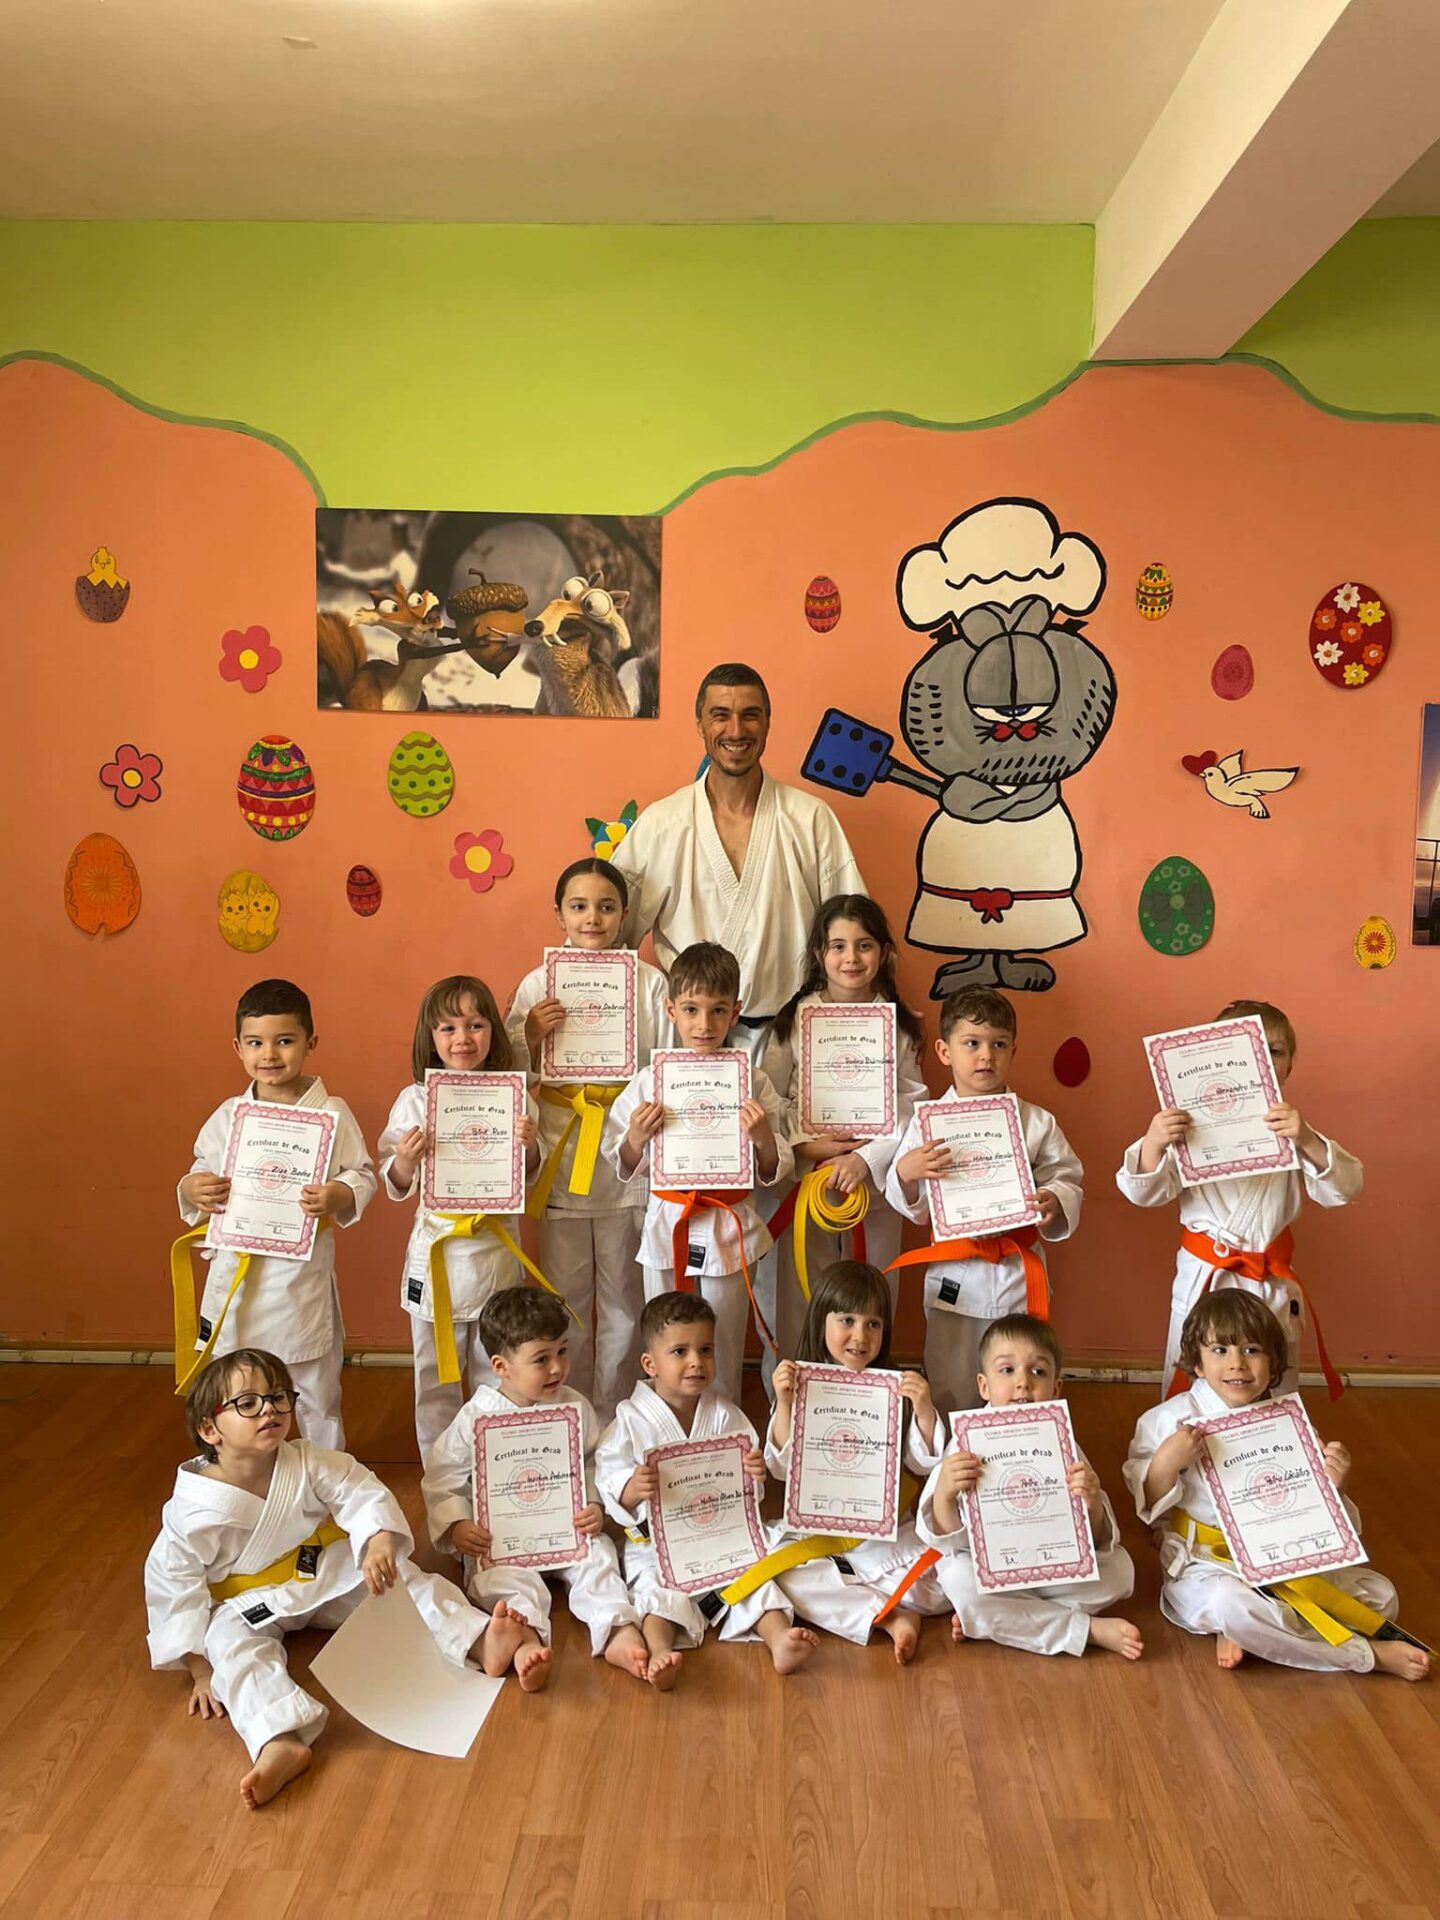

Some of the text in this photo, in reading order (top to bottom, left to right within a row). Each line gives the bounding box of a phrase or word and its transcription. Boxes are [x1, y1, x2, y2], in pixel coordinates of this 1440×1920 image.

[818, 1036, 847, 1044] Certificat
[1177, 1064, 1212, 1079] Certificat
[671, 1081, 701, 1090] Certificat
[444, 1106, 475, 1114] Certificat
[488, 1106, 505, 1114] Grad
[944, 1133, 971, 1143] ertificat
[247, 1139, 279, 1147] Certificat
[292, 1144, 310, 1154] Grad
[813, 1406, 847, 1415] Certificat
[861, 1410, 880, 1421] Grad
[495, 1447, 528, 1461] Certificat
[542, 1446, 561, 1454] Grad
[981, 1450, 1016, 1464] Certificat
[1032, 1448, 1053, 1457] Grad
[1224, 1450, 1258, 1468] Certificat
[1272, 1444, 1293, 1453] Grad
[667, 1475, 700, 1488] Certificat
